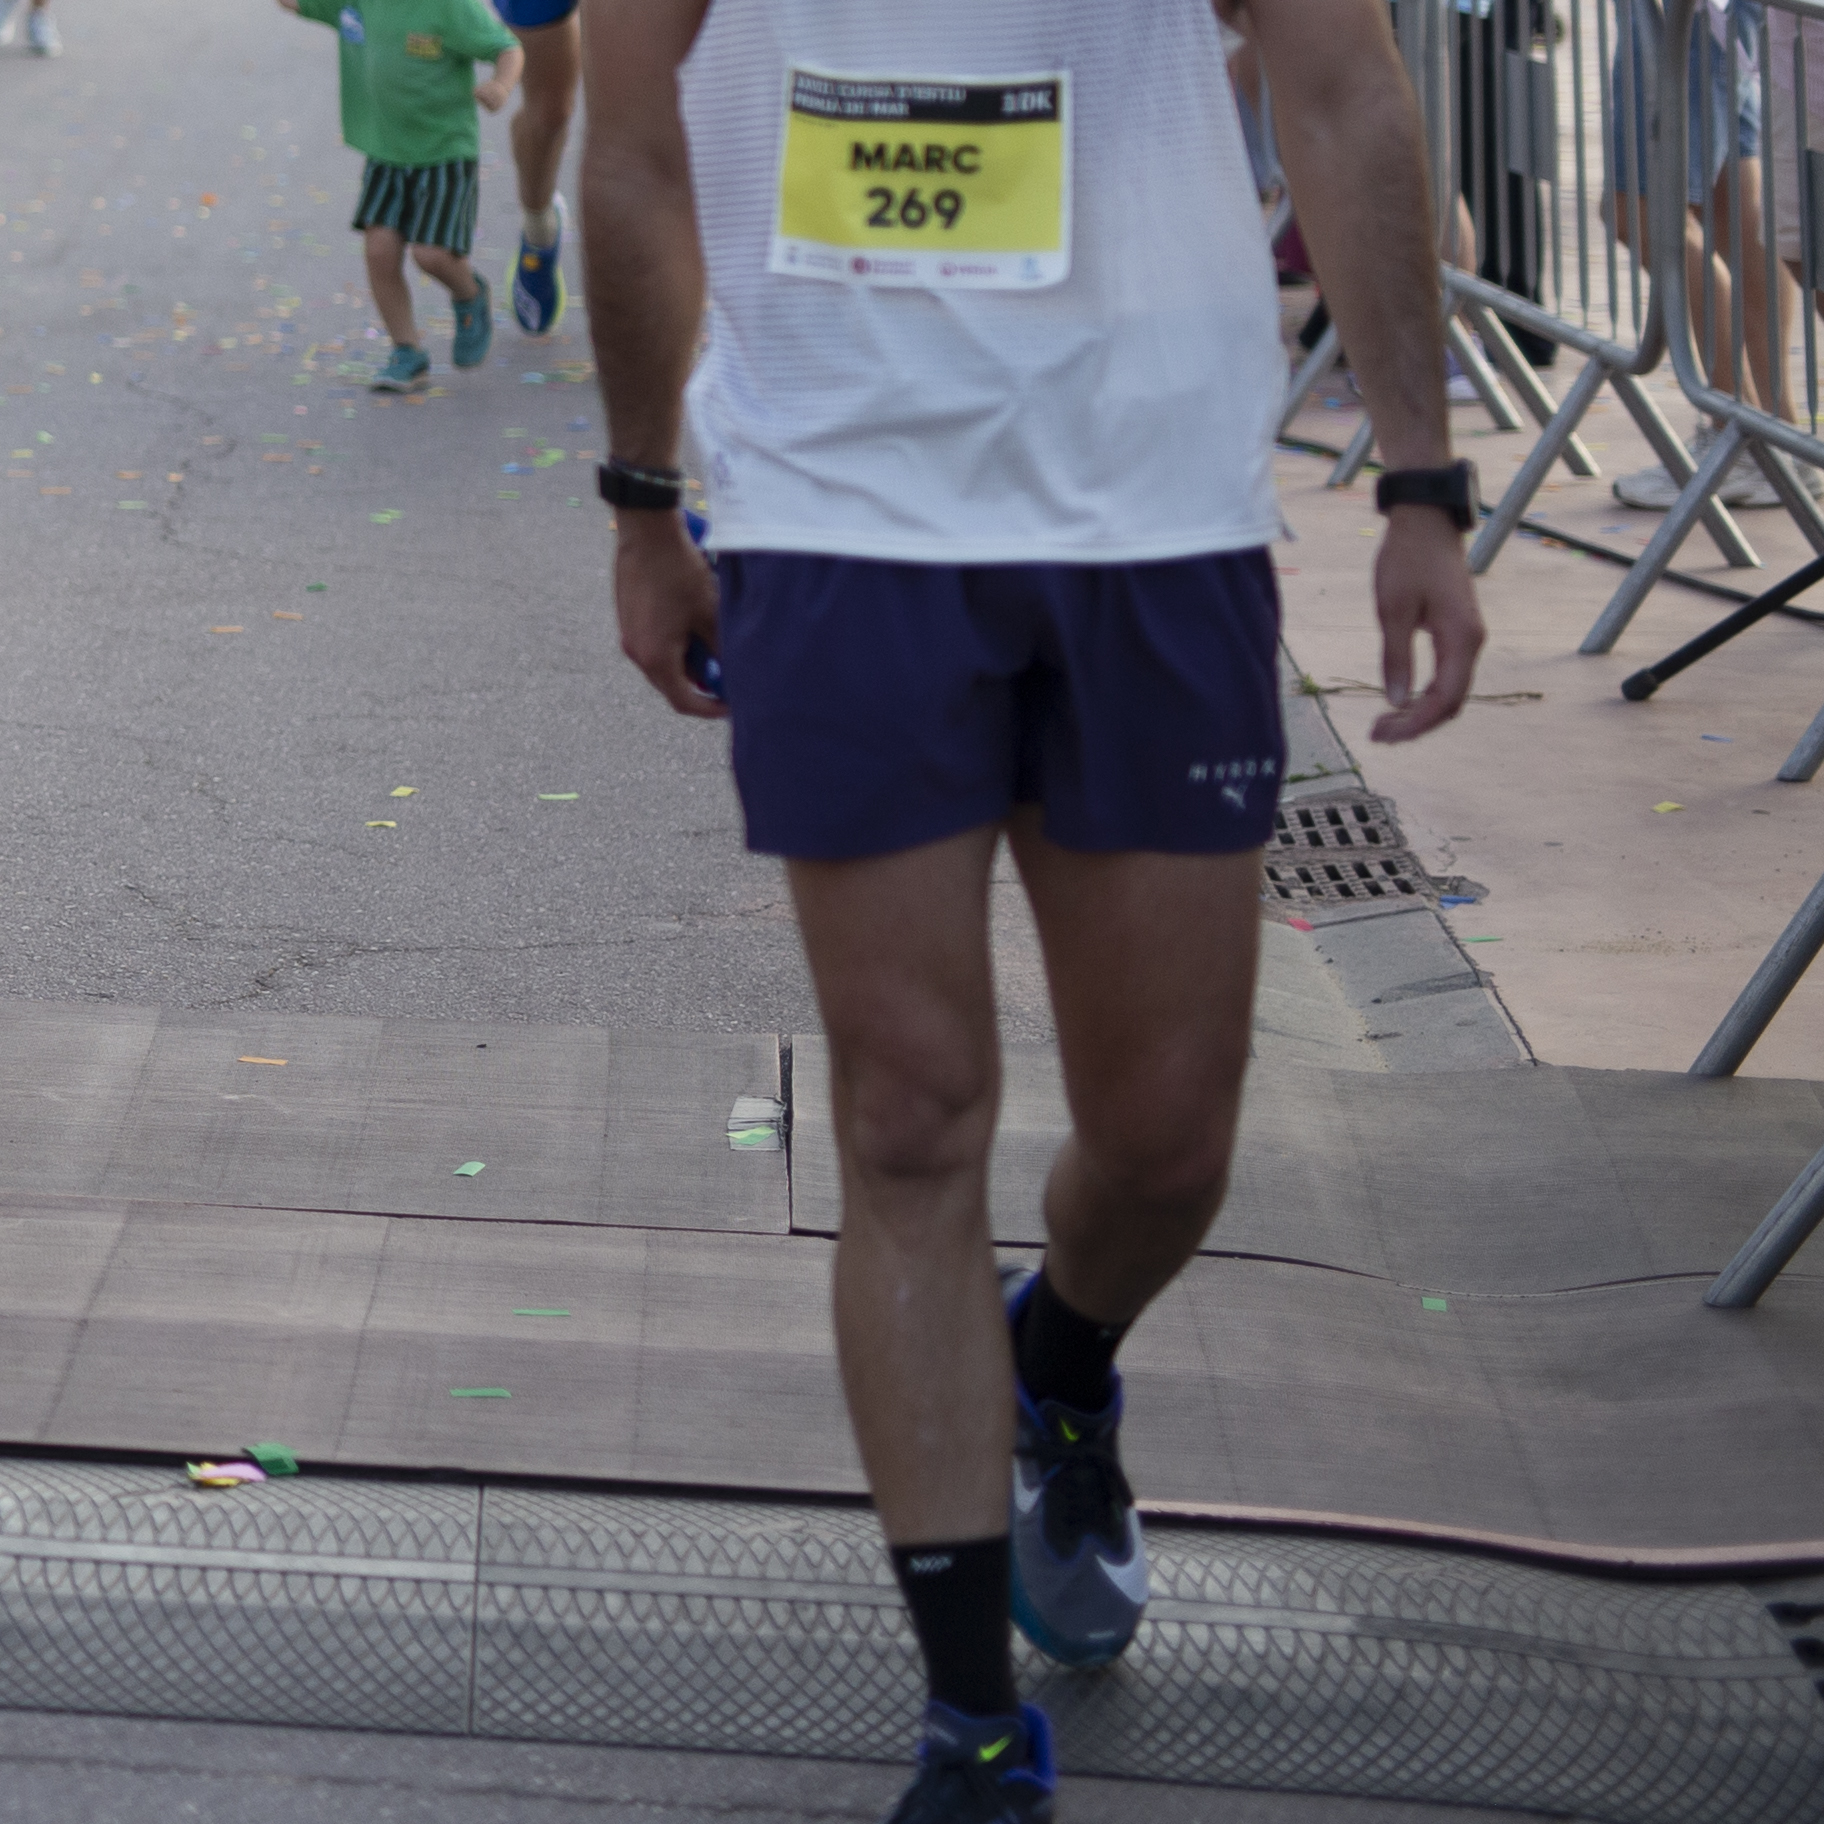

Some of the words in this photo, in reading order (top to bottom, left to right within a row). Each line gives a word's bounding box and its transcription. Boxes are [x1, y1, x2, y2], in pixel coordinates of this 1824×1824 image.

[1001, 90, 1054, 113] 10K
[849, 141, 982, 174] MARC
[867, 187, 964, 229] 269
